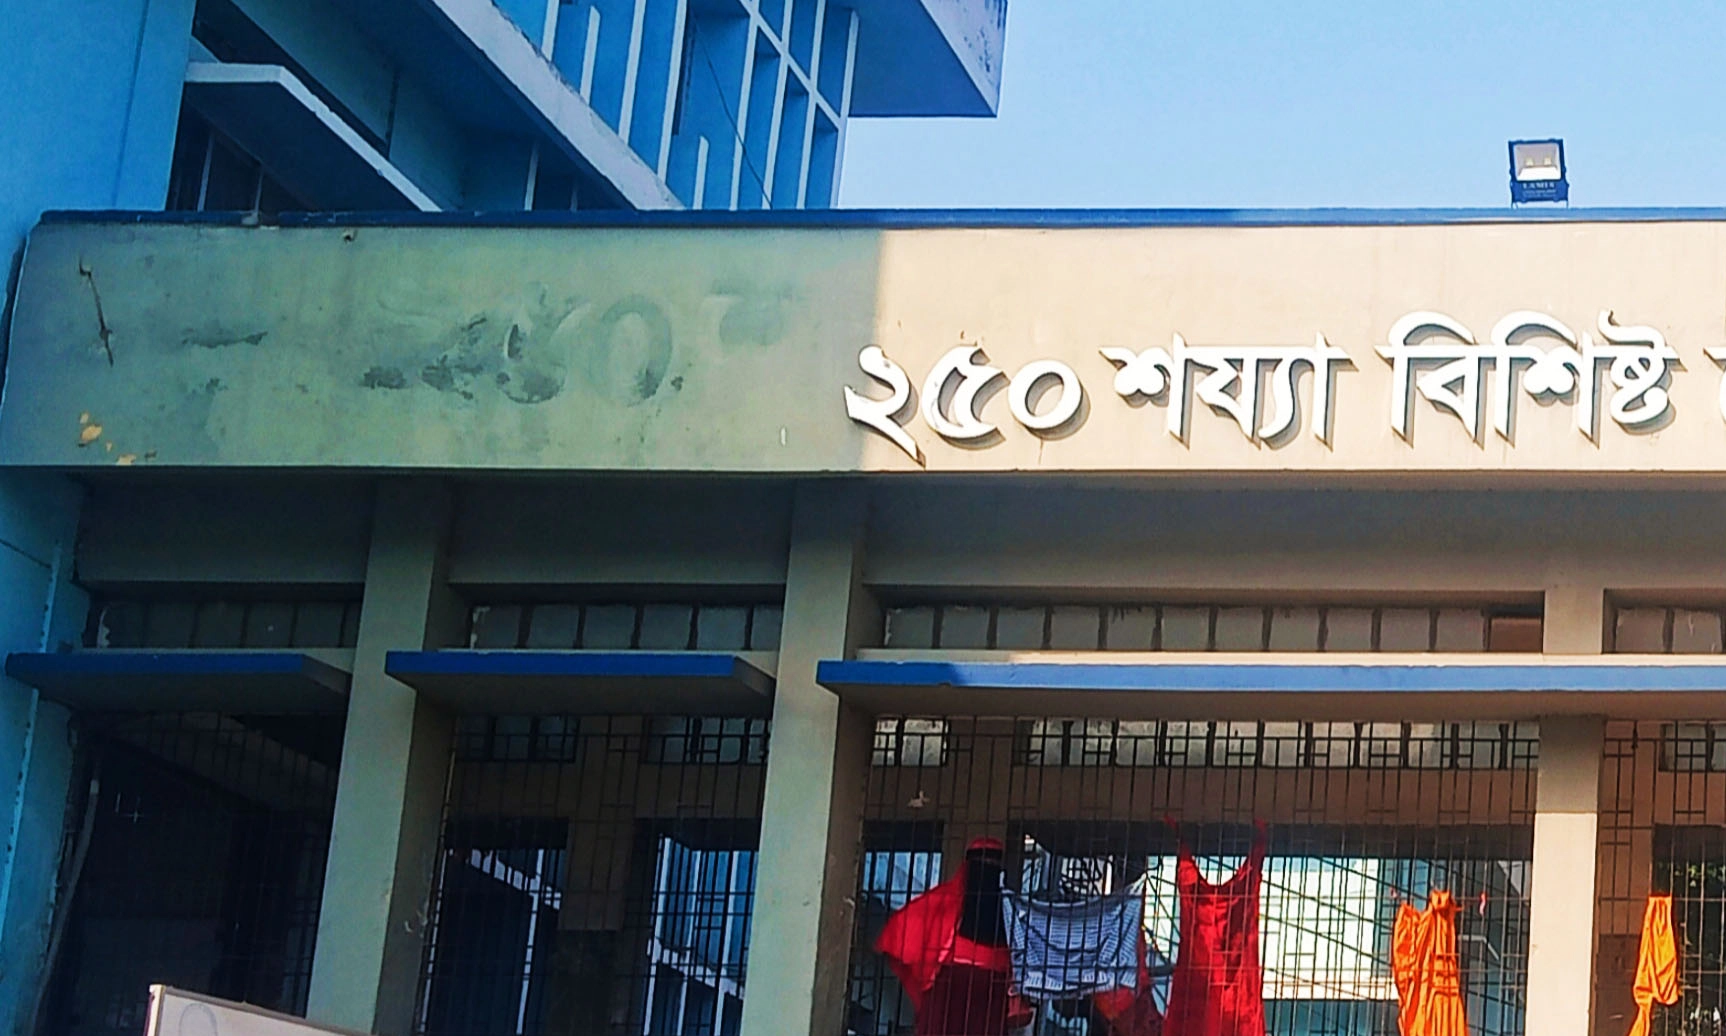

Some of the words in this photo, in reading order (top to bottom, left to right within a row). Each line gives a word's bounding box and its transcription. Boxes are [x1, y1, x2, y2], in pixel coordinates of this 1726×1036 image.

[845, 343, 1088, 465] ২৫০
[1099, 332, 1358, 450] শয্যা
[1375, 309, 1684, 449] বিশিষ্ট
